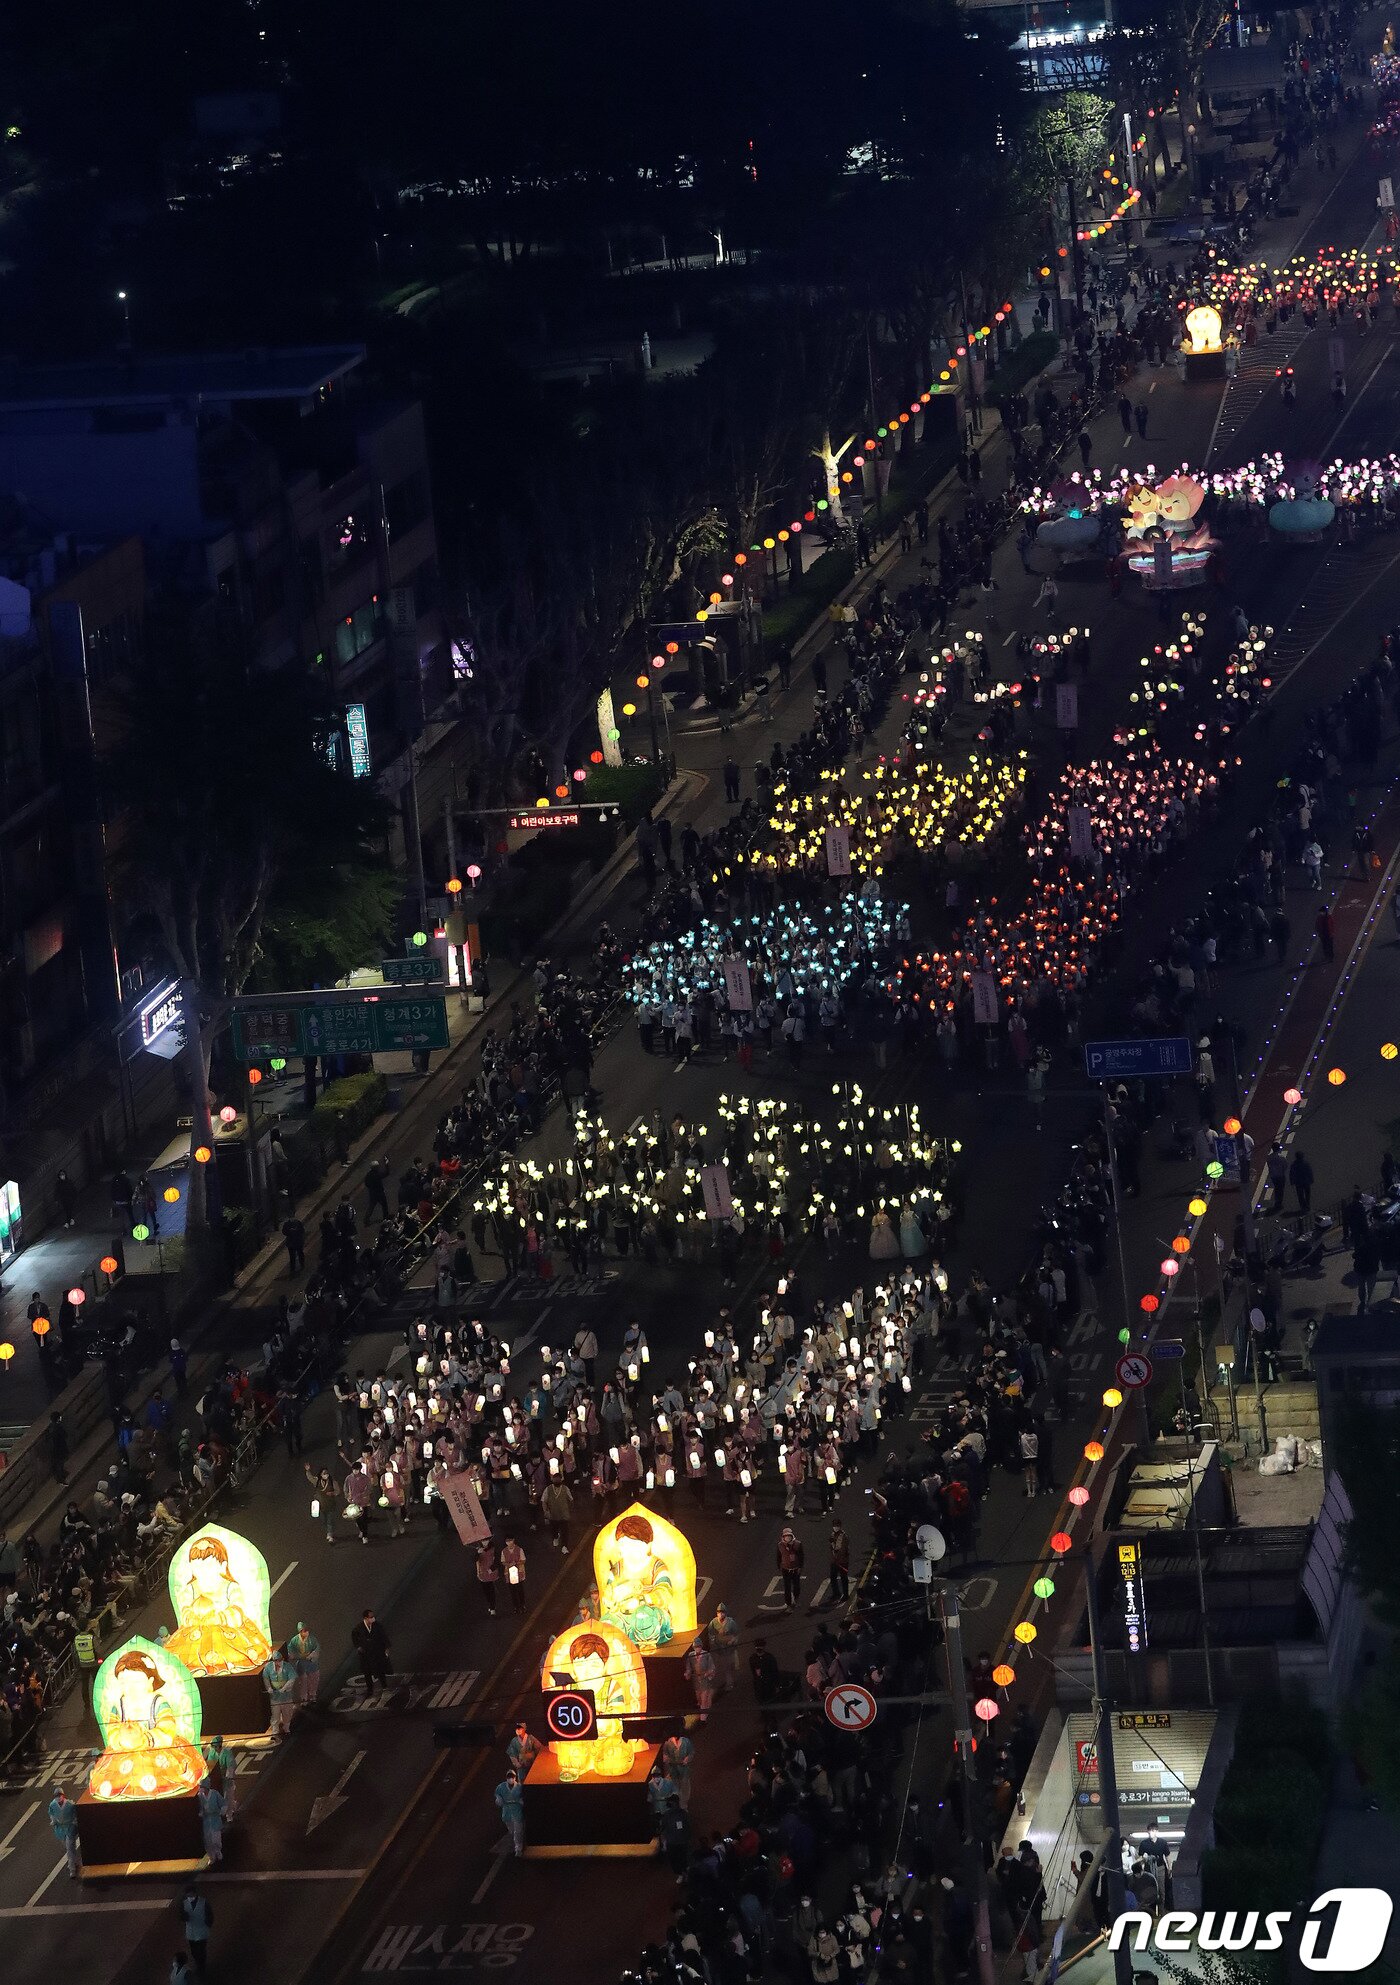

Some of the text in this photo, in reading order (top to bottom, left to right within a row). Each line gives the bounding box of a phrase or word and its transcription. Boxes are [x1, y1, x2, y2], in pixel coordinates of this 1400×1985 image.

[521, 814, 578, 827] 어린이보호구역
[386, 962, 437, 978] 종로3가
[557, 1705, 583, 1726] 50
[1119, 1791, 1151, 1803] 종로3가
